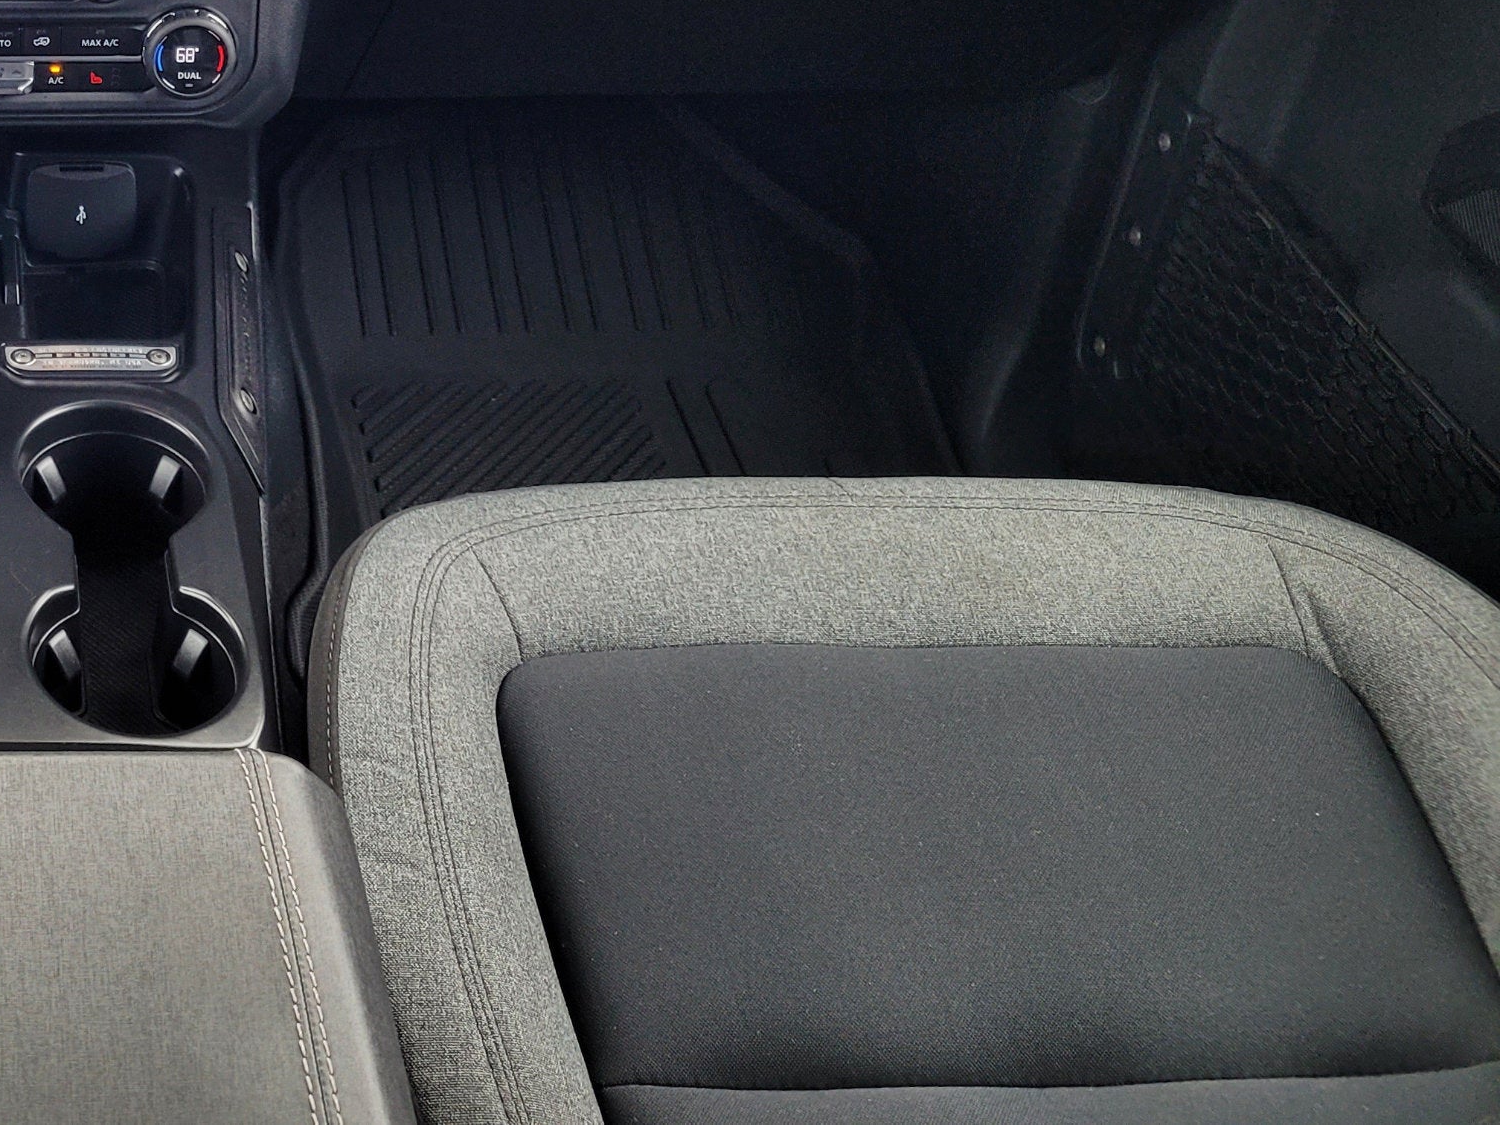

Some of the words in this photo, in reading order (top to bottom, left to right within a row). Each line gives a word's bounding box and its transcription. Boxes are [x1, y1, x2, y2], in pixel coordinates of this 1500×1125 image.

[81, 38, 102, 47] MAX
[103, 38, 120, 47] A/C
[177, 71, 202, 80] DUAL
[47, 76, 65, 85] A/C
